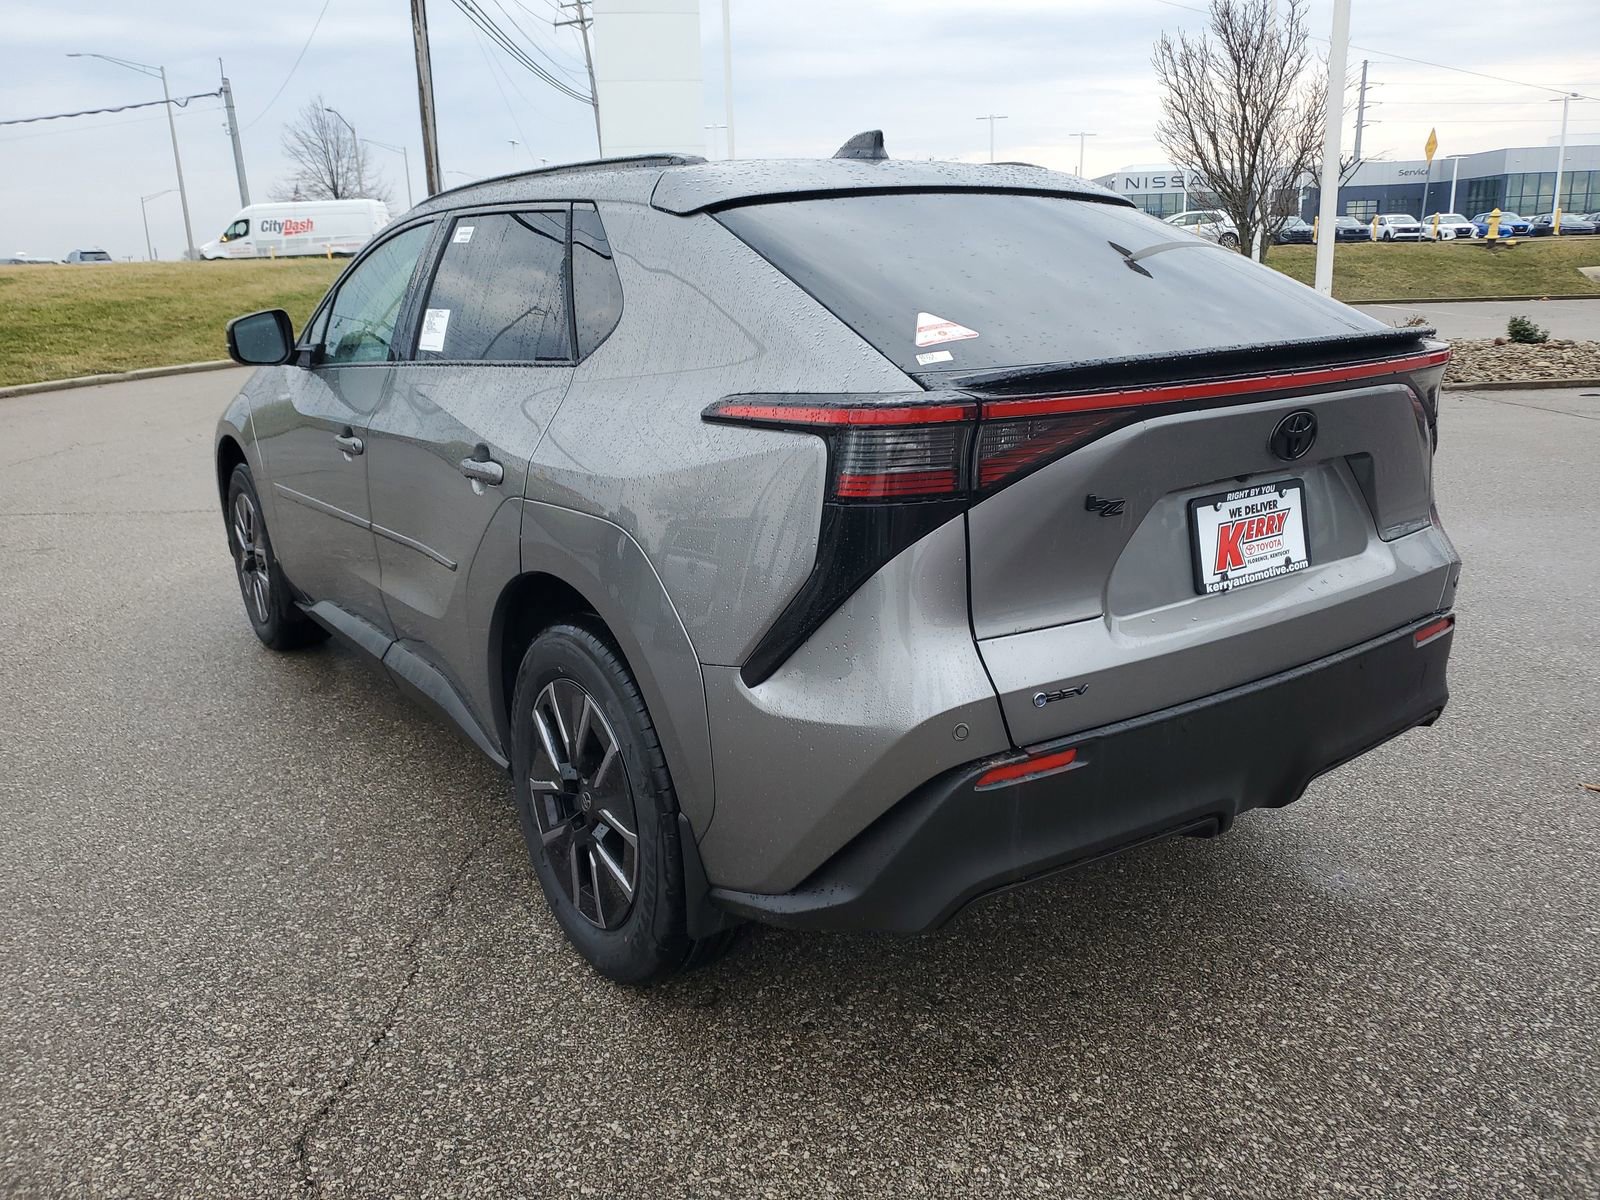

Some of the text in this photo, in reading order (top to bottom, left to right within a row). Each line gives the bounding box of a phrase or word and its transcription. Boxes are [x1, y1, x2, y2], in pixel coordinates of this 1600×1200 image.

[1125, 176, 1221, 189] NISSA
[261, 219, 314, 234] CityDash
[1227, 485, 1276, 501] RIGHT BY YOU
[1229, 499, 1278, 519] WE DELIVER
[1215, 510, 1289, 574] KERRY
[1256, 540, 1282, 552] TOYOTA
[1247, 549, 1290, 565] FLORENCE, KENTUCKY
[1206, 559, 1309, 594] kerryautomotive.com
